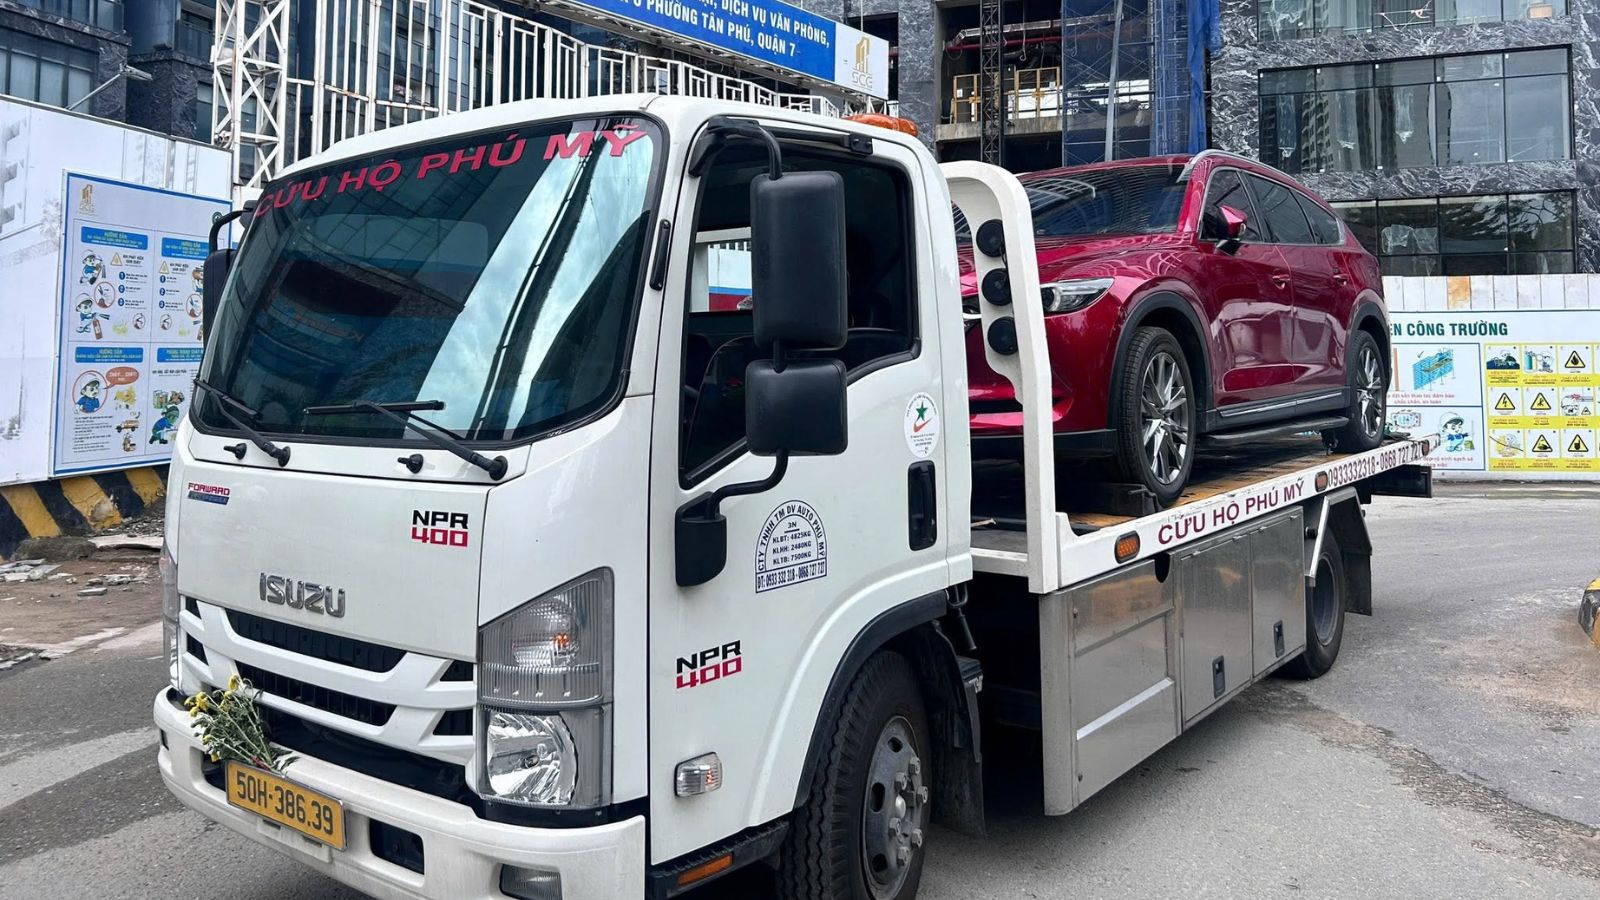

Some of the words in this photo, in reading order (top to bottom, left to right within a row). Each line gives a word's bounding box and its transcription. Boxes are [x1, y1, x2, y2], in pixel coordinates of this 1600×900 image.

[701, 12, 724, 34] TÂN
[727, 22, 754, 47] PHÚ,
[757, 32, 786, 55] QUẬN
[789, 43, 796, 57] 7
[752, 5, 767, 27] VỤ
[770, 11, 790, 33] VĂN
[793, 21, 830, 48] PHÒNG,
[255, 175, 329, 217] CỨU
[337, 159, 402, 193] HỘ
[416, 134, 526, 180] PHÚ
[543, 123, 650, 160] MỸ
[1406, 320, 1445, 336] CÔNG
[1449, 320, 1508, 336] TRƯỜNG
[188, 483, 230, 496] FORWARD
[1213, 501, 1240, 525] HỘ
[1245, 486, 1278, 515] PHÚ
[1283, 476, 1305, 502] MỸ
[412, 510, 469, 529] NPR
[774, 508, 786, 521] TM
[786, 505, 796, 514] DV
[797, 505, 814, 521] AUTO
[412, 527, 468, 547] 400
[760, 519, 775, 546] TNHH
[787, 521, 797, 529] 3N
[757, 550, 765, 571] CTY
[259, 572, 346, 618] ISUZU
[676, 639, 742, 674] NPR
[676, 655, 742, 689] 400
[236, 770, 334, 835] 50H-386.39
